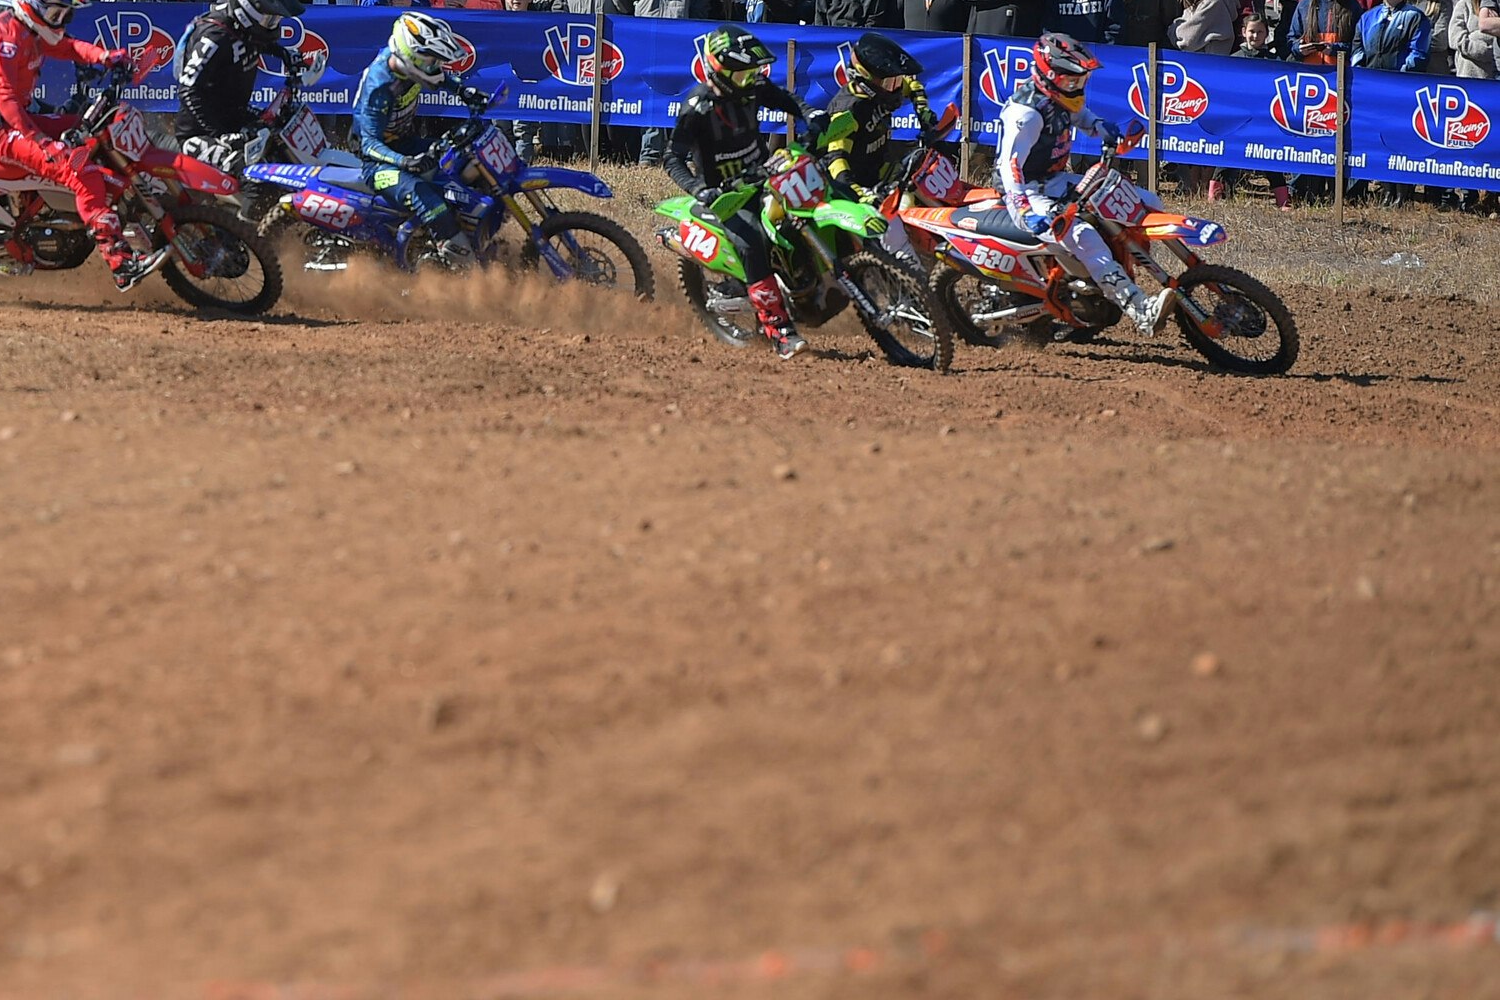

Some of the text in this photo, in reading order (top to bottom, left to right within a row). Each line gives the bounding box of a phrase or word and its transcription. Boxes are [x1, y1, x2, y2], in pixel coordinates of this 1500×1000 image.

[544, 23, 599, 83] VP
[1165, 96, 1208, 116] Racing
[1274, 72, 1329, 133] VP
[1416, 84, 1470, 146] VP
[1163, 114, 1192, 124] FUELS
[1306, 126, 1334, 135] FUELS
[1448, 121, 1490, 140] Racing
[1447, 138, 1476, 148] FUELS
[269, 174, 307, 188] DUNLOP
[925, 156, 959, 199] 902
[1388, 154, 1500, 180] #MoreThanRaceFue
[779, 162, 825, 208] 114
[1104, 180, 1142, 221] 530
[300, 193, 355, 229] 523
[682, 222, 719, 259] 114
[971, 245, 1017, 274] 530
